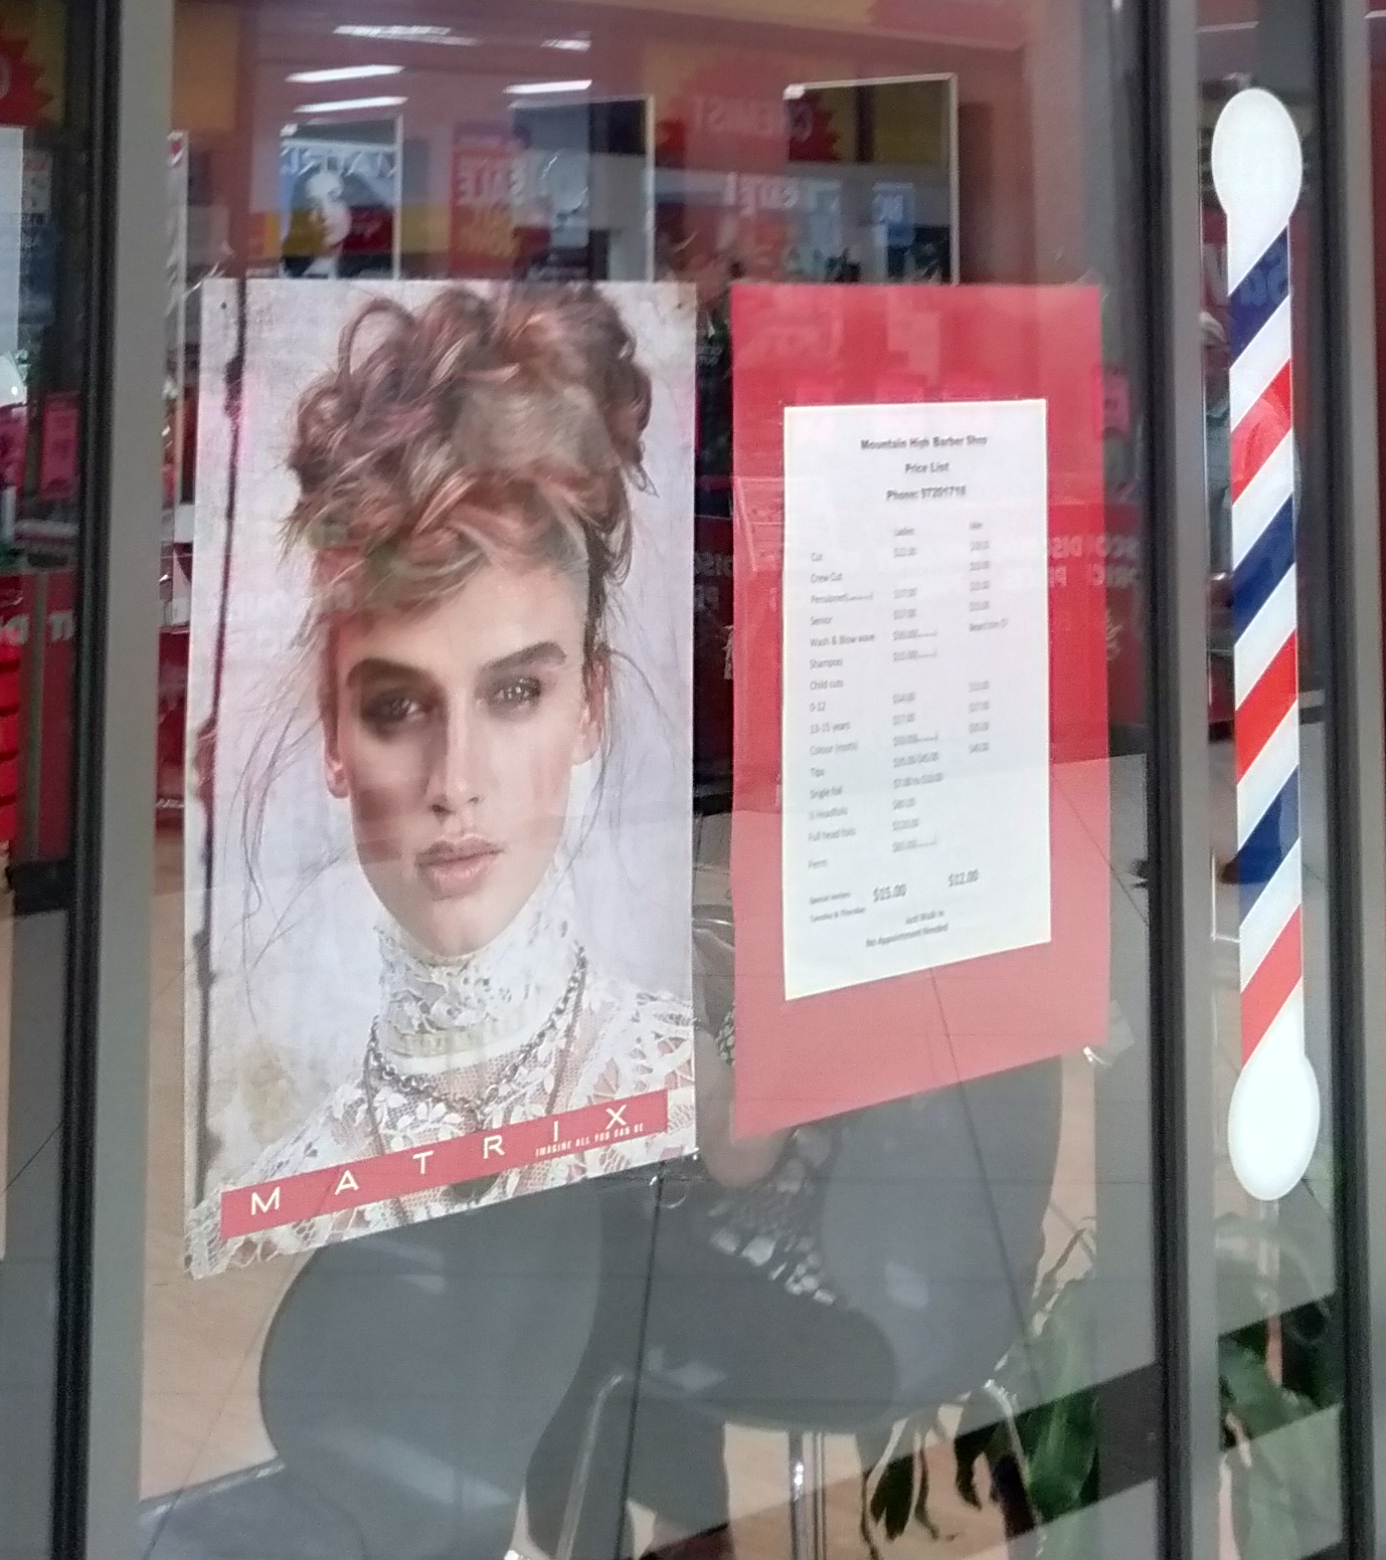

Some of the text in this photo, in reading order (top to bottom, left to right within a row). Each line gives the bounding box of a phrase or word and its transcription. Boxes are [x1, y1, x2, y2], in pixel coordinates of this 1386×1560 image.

[861, 434, 987, 450] Mountain High Barber Shop
[905, 462, 949, 474] Price List
[810, 658, 843, 670] Shampoo
[810, 680, 827, 690] Child
[535, 1140, 572, 1157] IMAGINE
[250, 1105, 628, 1217] MATRIX
